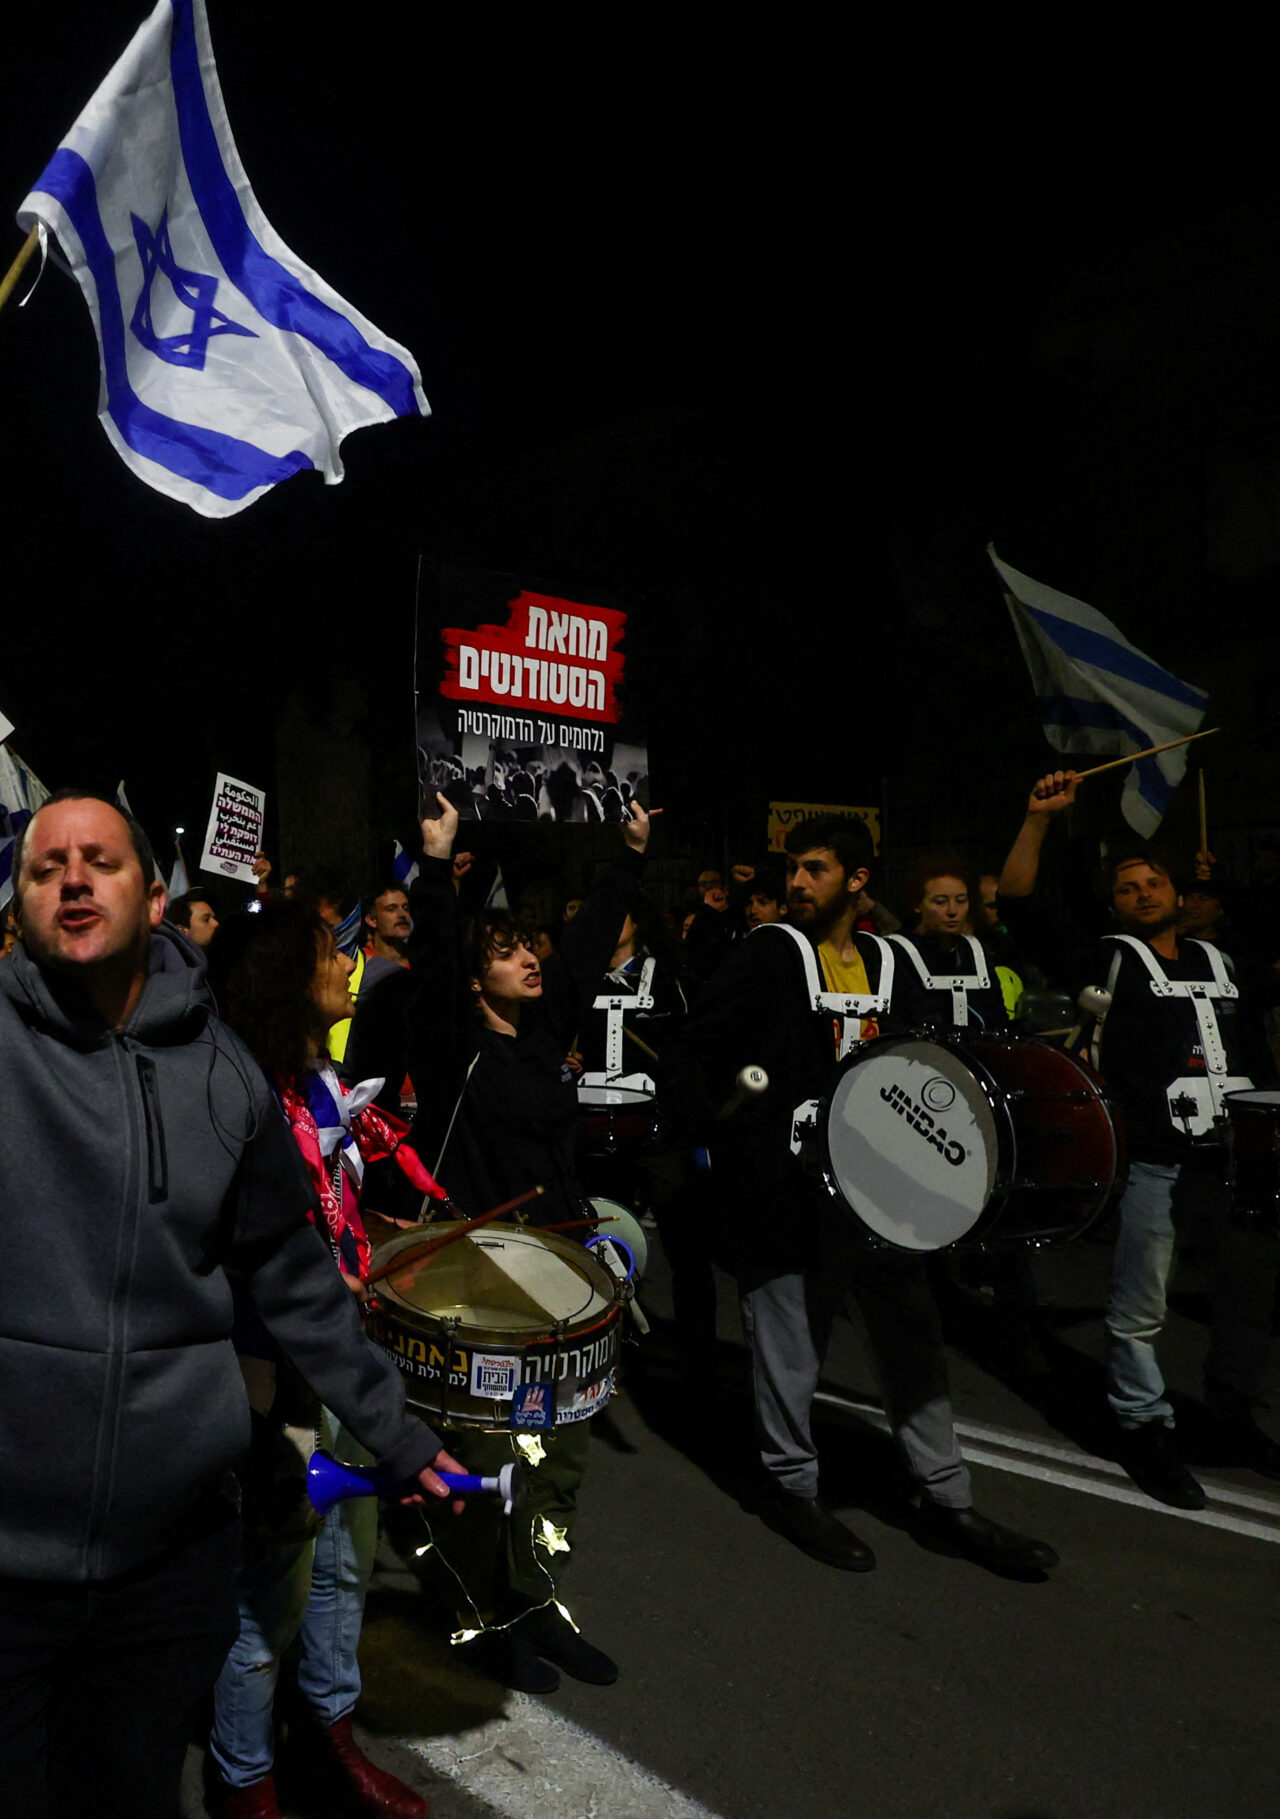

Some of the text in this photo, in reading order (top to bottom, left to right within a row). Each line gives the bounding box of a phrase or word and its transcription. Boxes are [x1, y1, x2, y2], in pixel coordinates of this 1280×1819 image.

[525, 606, 609, 661] מחאת
[459, 645, 606, 710] הסטודנטים
[458, 709, 604, 752] נלחמים על הדמוקרטיה
[218, 797, 262, 824] הממשלה
[212, 846, 241, 861] העתיד
[880, 1084, 965, 1166] JINDAO
[417, 1365, 468, 1386] למילת
[482, 1372, 508, 1384] הבית
